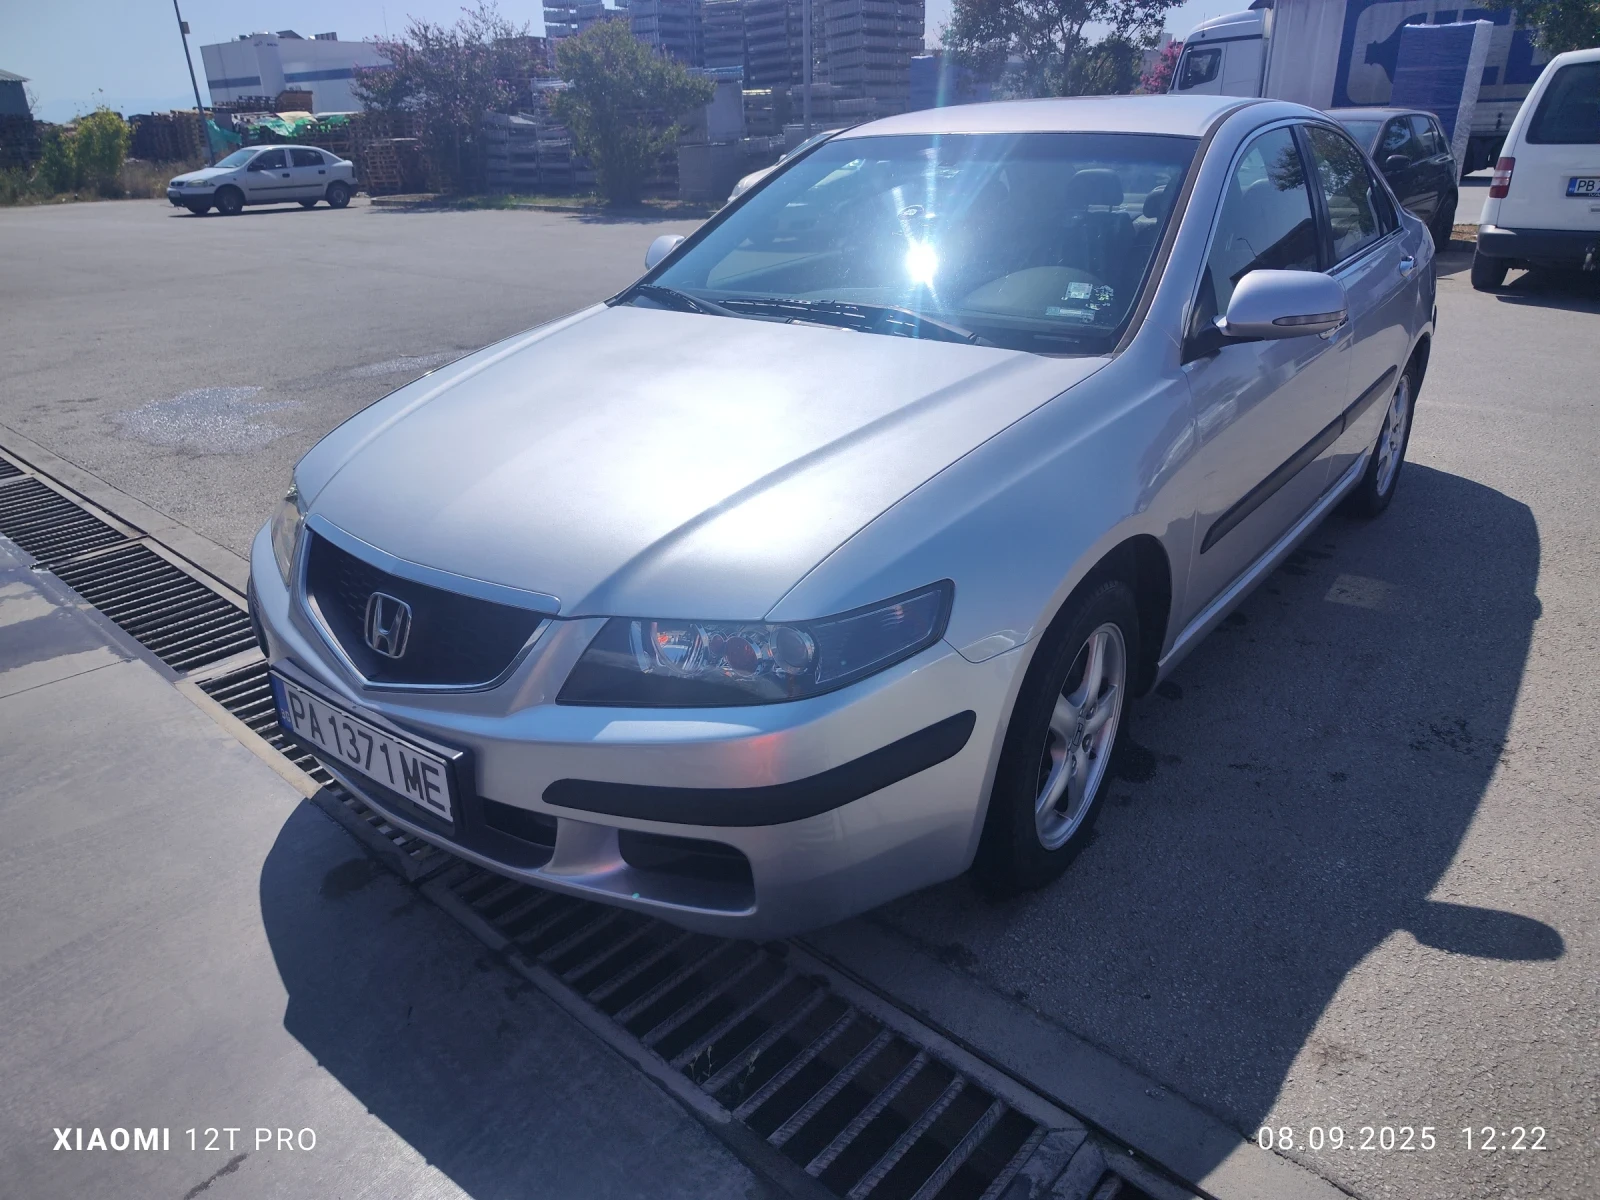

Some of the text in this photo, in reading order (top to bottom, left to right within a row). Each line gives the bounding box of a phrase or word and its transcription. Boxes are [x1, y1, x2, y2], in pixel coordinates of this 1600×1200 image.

[1577, 180, 1596, 192] PB
[288, 690, 447, 813] PA 1371 ME
